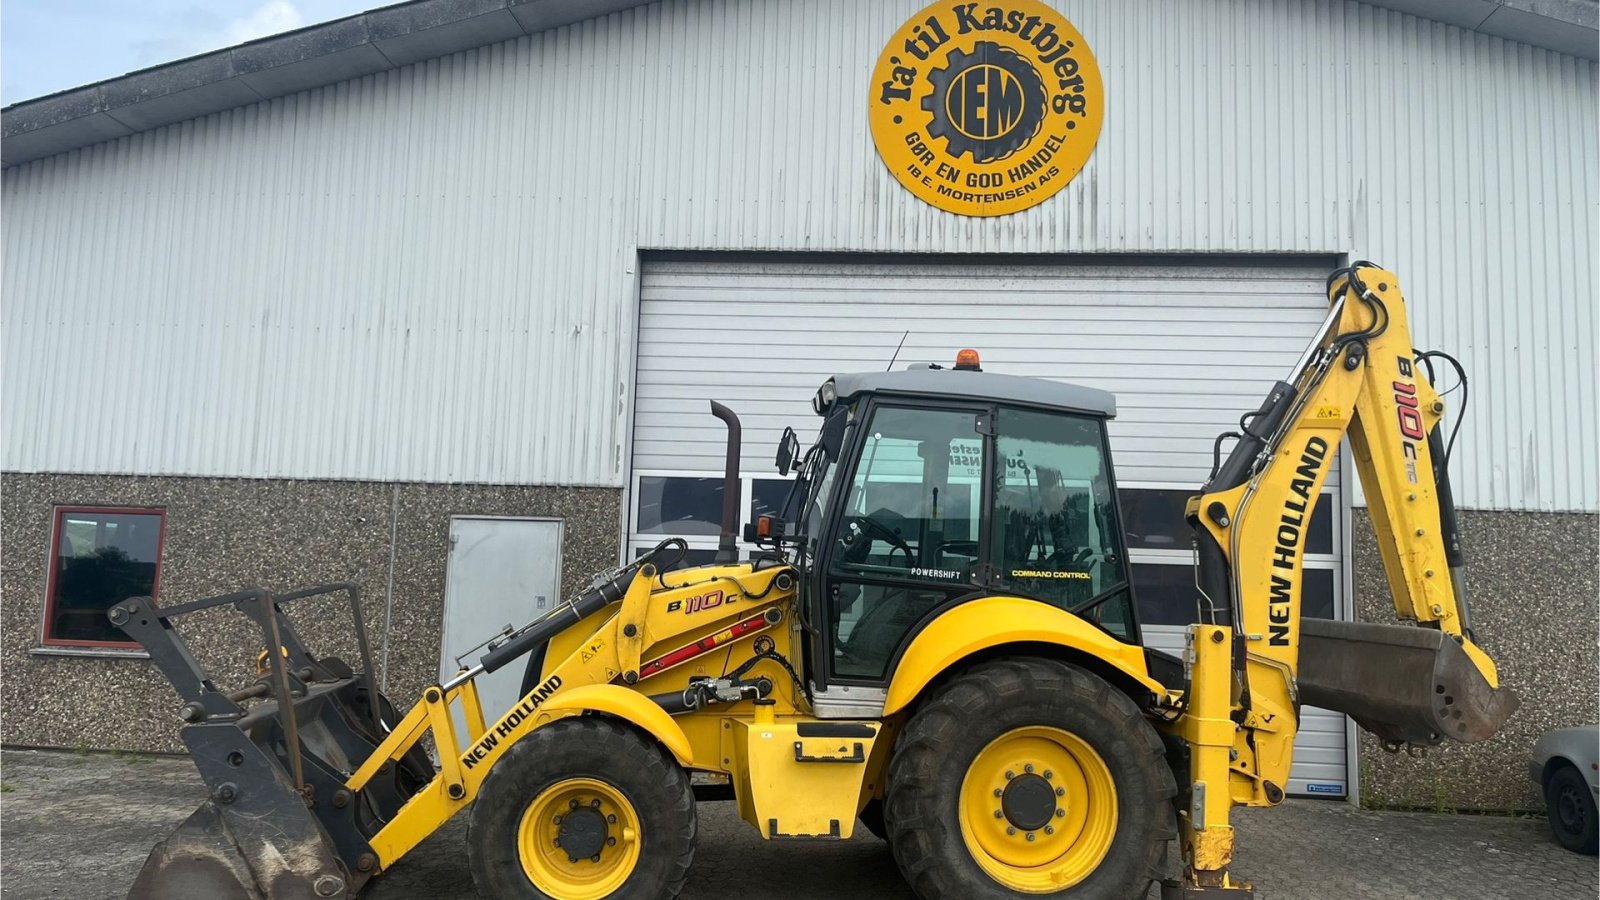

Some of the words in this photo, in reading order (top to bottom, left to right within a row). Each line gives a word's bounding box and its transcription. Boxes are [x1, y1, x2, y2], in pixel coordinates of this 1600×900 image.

[880, 56, 918, 105] Ta'
[905, 15, 950, 61] til
[952, 2, 1087, 117] Kastbjerg
[905, 131, 936, 167] GØR
[935, 161, 961, 183] EN
[966, 172, 1003, 188] GOD
[1007, 134, 1067, 183] HANDEL
[907, 163, 923, 179] IB
[921, 175, 933, 188] E.
[936, 182, 1038, 203] MORTENSEN
[1038, 165, 1060, 186] A/S
[1272, 436, 1329, 570] HOLLAND
[911, 568, 961, 580] POWERSHIFT
[1012, 570, 1052, 579] COMMAND
[1053, 571, 1091, 580] CONTROL
[1269, 575, 1292, 647] NEW
[462, 733, 499, 770] NEW
[495, 675, 562, 739] HOLLAND
